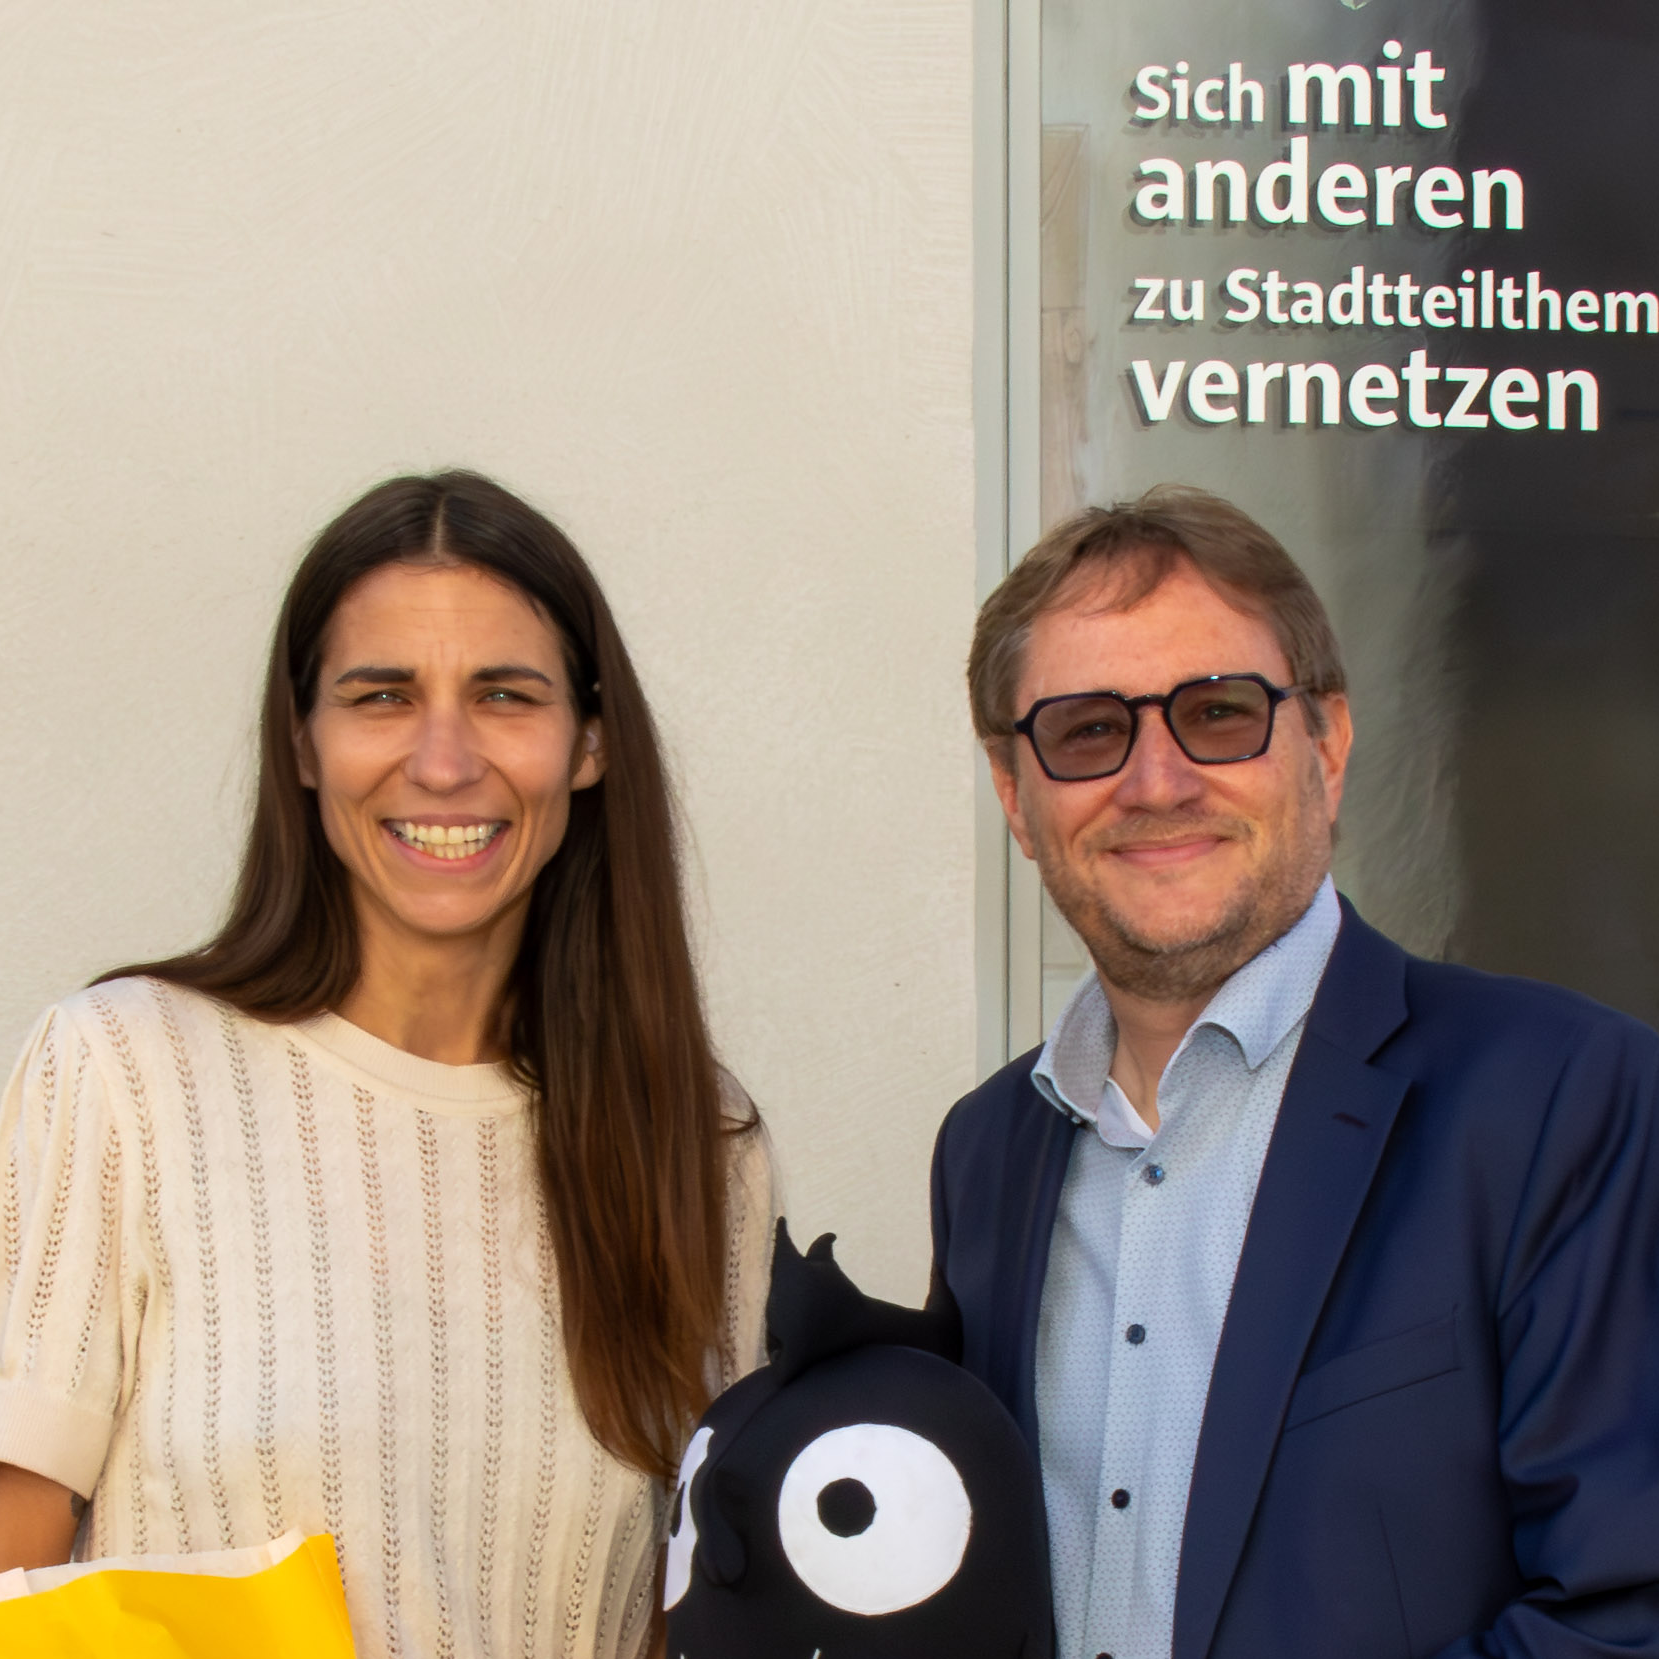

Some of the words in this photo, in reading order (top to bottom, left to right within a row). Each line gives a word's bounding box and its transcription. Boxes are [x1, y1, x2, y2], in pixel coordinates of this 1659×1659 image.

[1134, 60, 1264, 123] Sich
[1286, 39, 1447, 132] mit
[1135, 136, 1524, 231] anderen
[1132, 273, 1205, 322] zu
[1131, 349, 1599, 432] vernetzen
